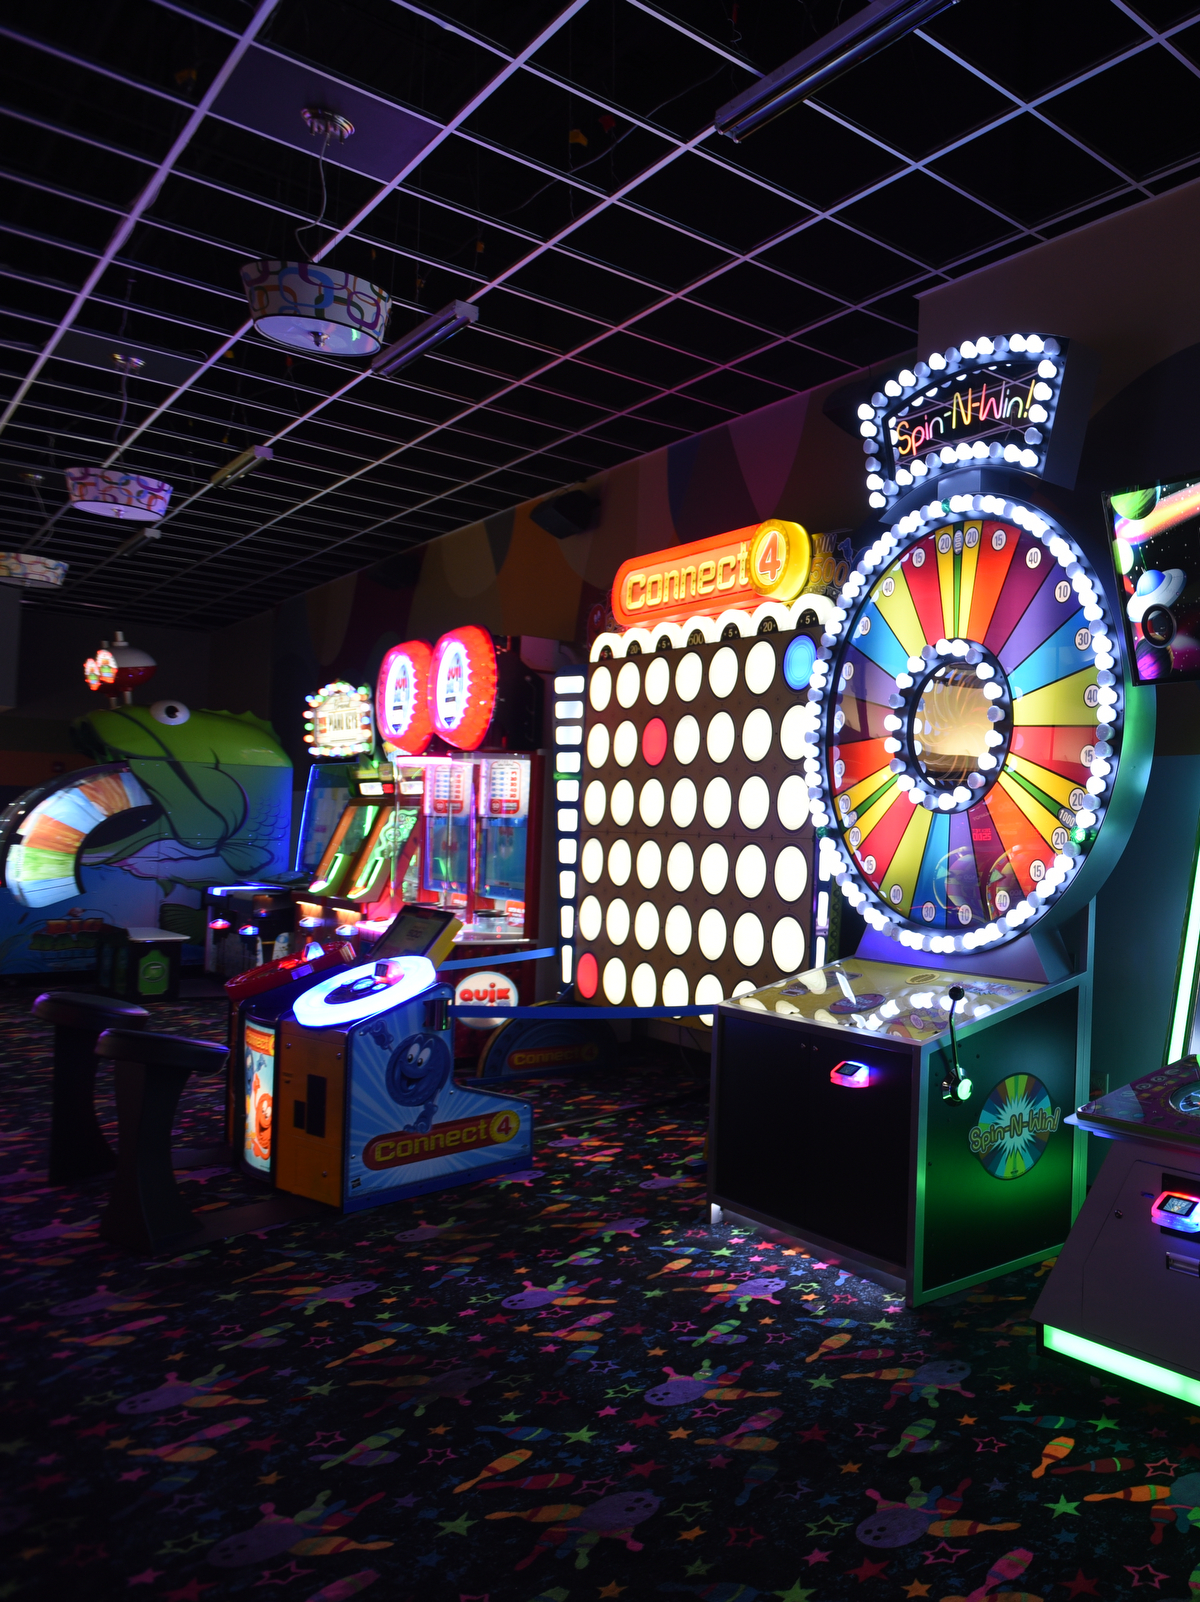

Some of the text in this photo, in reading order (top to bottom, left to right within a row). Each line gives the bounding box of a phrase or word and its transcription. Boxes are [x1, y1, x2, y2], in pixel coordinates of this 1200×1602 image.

[896, 379, 1036, 456] Spin-N-Win!
[940, 536, 950, 551] 20
[954, 532, 962, 554] 1000
[967, 531, 977, 544] 20
[994, 533, 1003, 547] 15
[812, 534, 837, 557] WIN
[914, 551, 924, 564] 15
[1028, 551, 1039, 565] 40
[625, 531, 783, 611] Connect 4
[809, 556, 849, 589] 500
[883, 579, 894, 594] 40
[1058, 584, 1068, 599] 10
[763, 621, 773, 633] 20
[1077, 631, 1089, 647] 30
[1086, 689, 1098, 704] 40
[1084, 749, 1094, 763] 15
[1072, 792, 1083, 807] 20
[1059, 810, 1076, 827] 1000
[851, 830, 860, 844] 20
[1054, 831, 1066, 846] 20
[1033, 863, 1042, 878] 15
[892, 887, 901, 901] 40
[923, 905, 935, 919] 30
[960, 907, 971, 922] 10
[513, 1046, 579, 1067] Connect
[968, 1107, 1061, 1153] Spin-N-Win!
[374, 1115, 512, 1163] Connect 4
